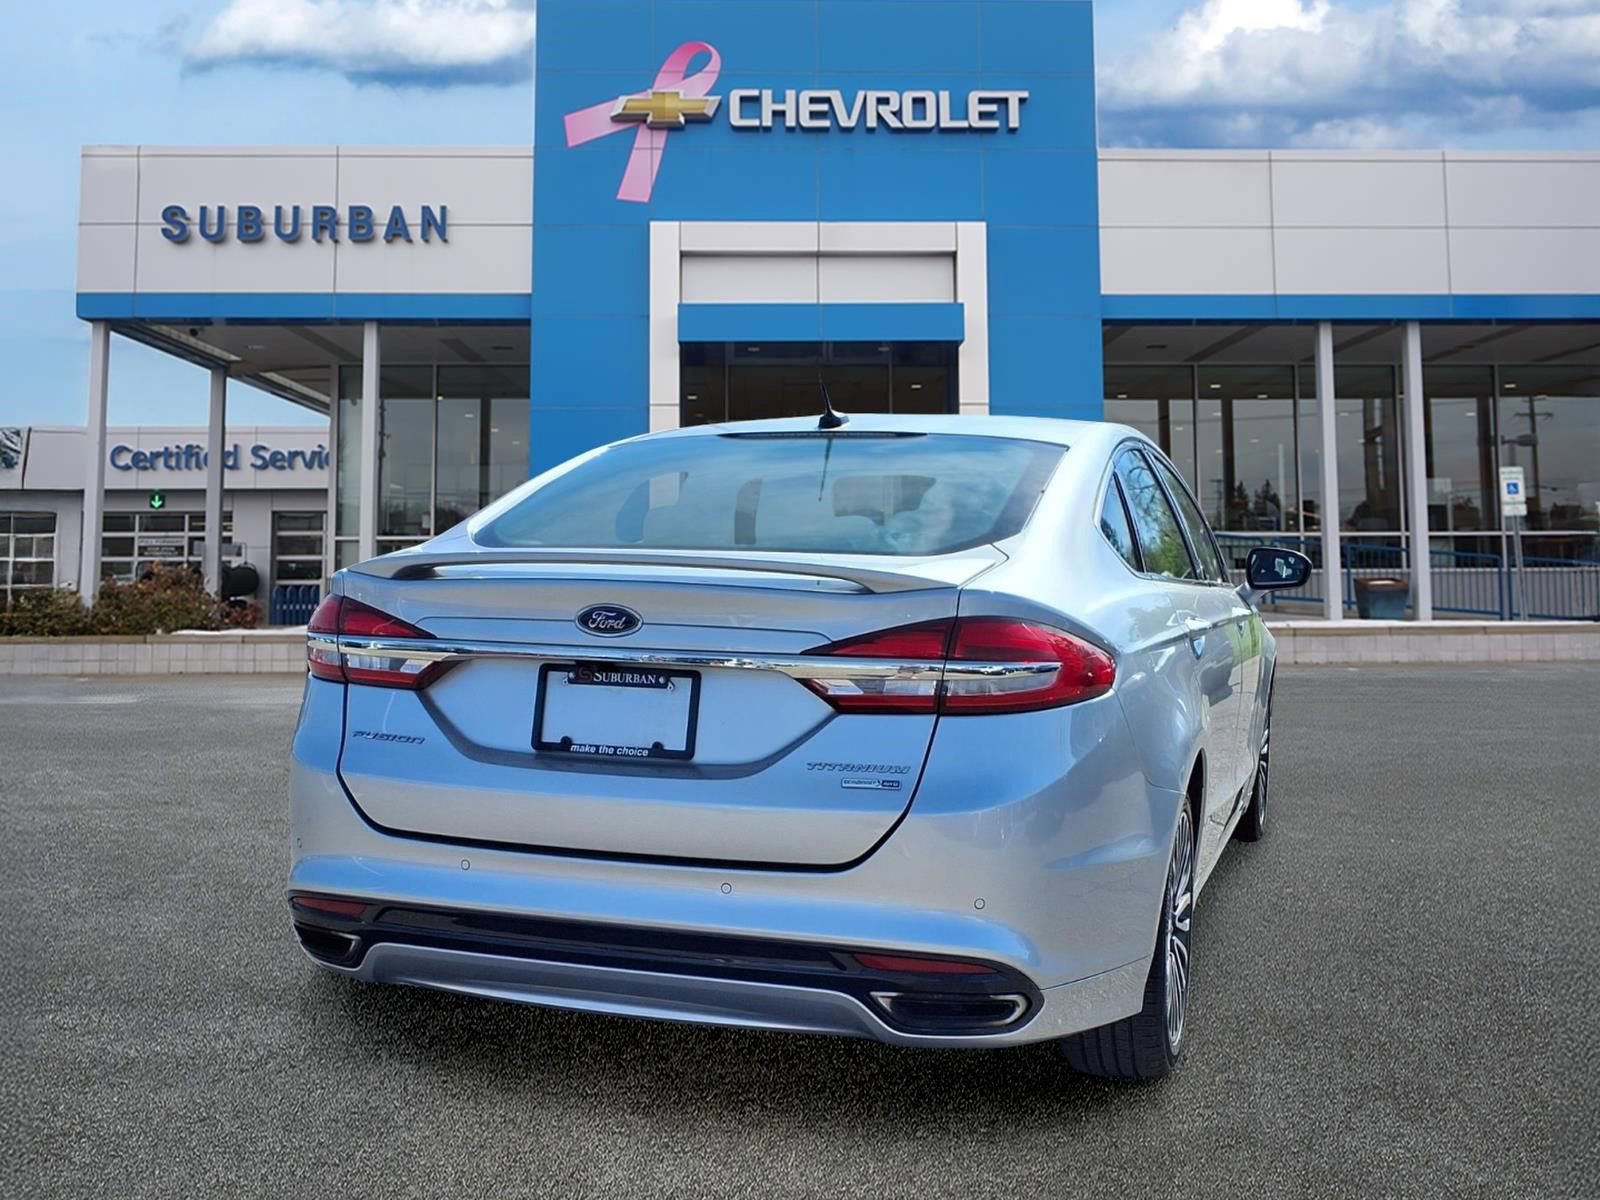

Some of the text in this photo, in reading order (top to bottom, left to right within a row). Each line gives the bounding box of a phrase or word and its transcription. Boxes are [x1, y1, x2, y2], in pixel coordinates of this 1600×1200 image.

[728, 88, 1029, 131] CHEVROLET
[160, 204, 449, 244] SUBURBAN
[110, 443, 240, 471] Certifid
[588, 609, 626, 630] Ford
[593, 671, 657, 685] SUBURBAN
[352, 730, 426, 745] FUSION
[570, 744, 649, 757] make the choice
[806, 762, 912, 775] TITANIUM
